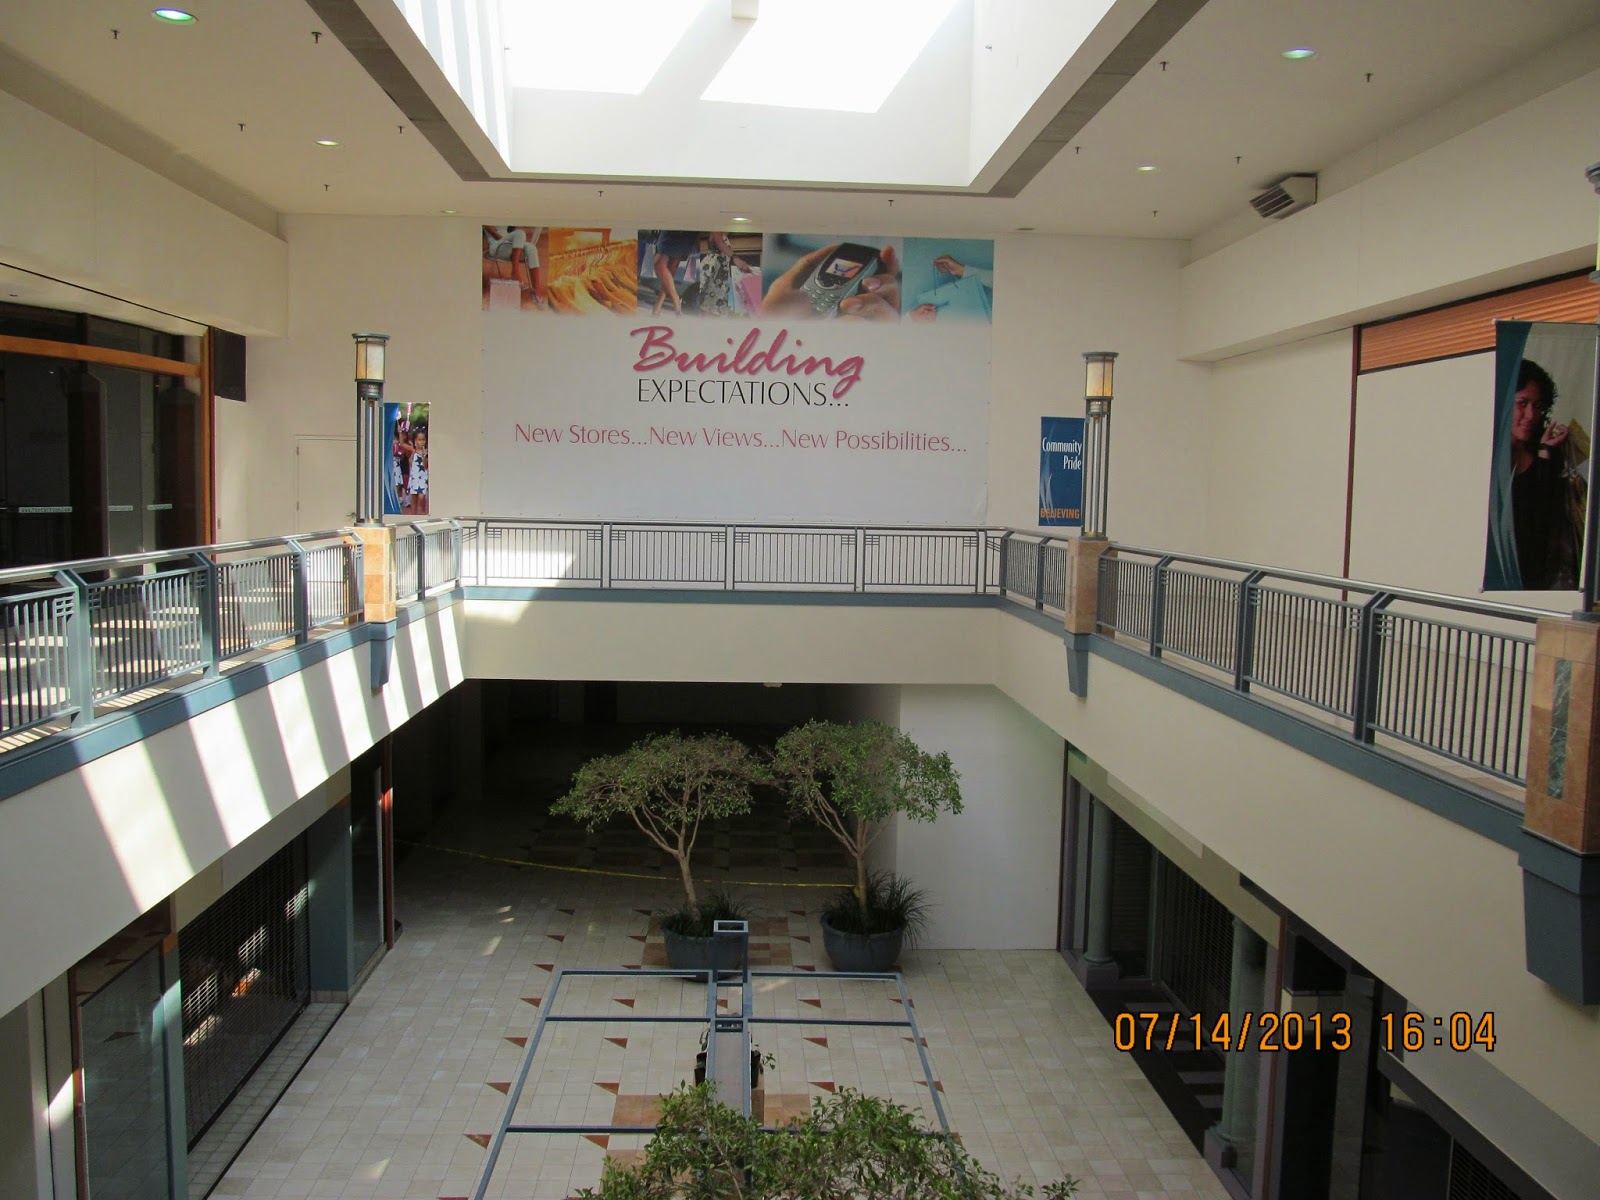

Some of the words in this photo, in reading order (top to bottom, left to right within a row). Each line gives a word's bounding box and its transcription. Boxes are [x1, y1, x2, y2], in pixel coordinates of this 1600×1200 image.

[629, 325, 865, 399] Building
[515, 424, 564, 443] New
[1042, 437, 1082, 455] Community
[1063, 455, 1082, 470] Pride
